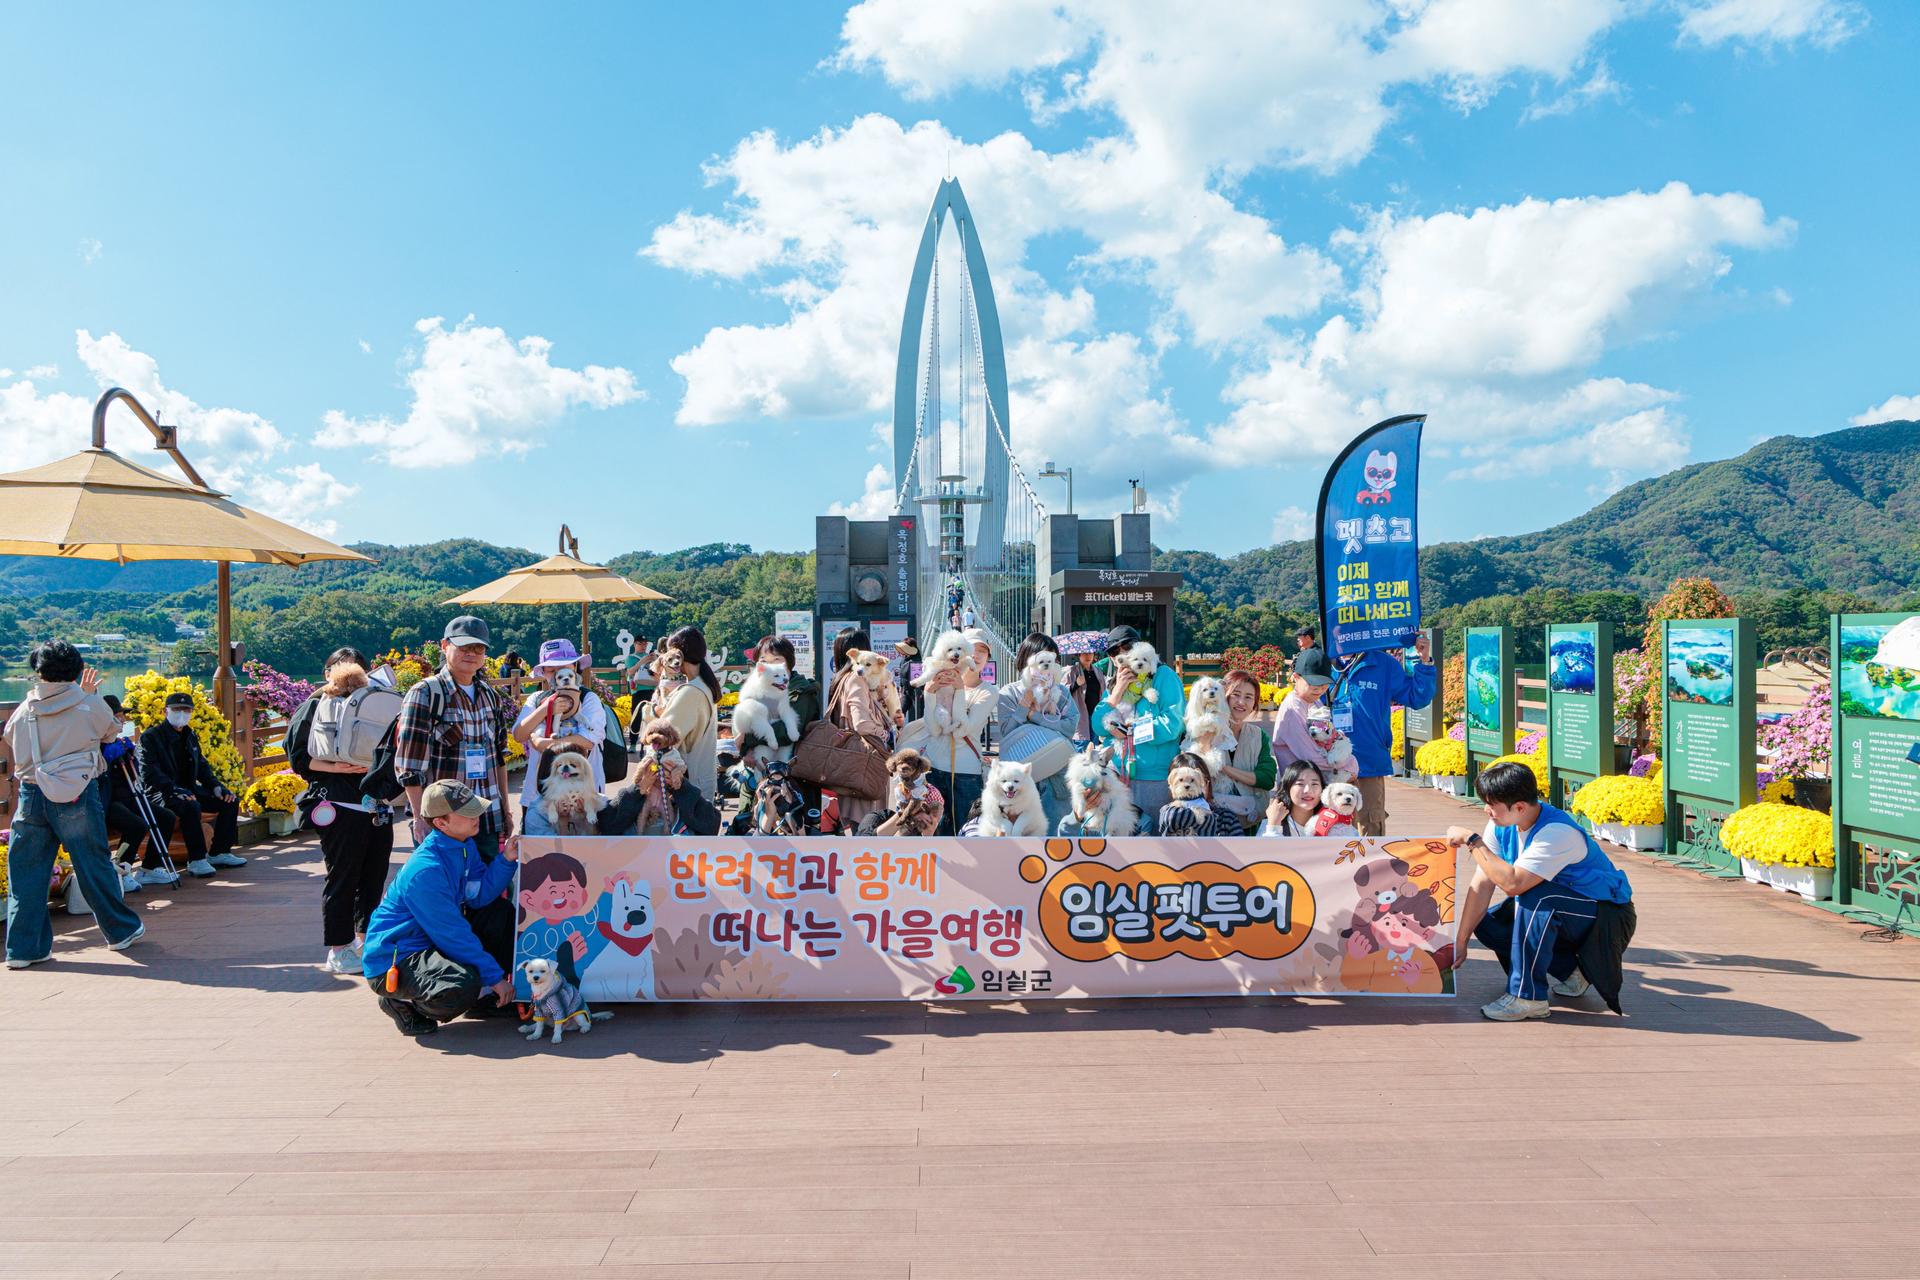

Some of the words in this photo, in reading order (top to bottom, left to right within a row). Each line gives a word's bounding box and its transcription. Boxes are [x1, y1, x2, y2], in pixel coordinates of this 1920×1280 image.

[1335, 514, 1413, 554] 펫츠고
[1337, 562, 1369, 581] 이제
[1085, 592, 1126, 602] 표(Ticket)
[1127, 592, 1144, 602] 받는
[1145, 592, 1153, 602] 곳
[1337, 583, 1370, 603] 펫과
[1374, 580, 1409, 599] 함께
[1338, 601, 1411, 624] 떠나세요!
[1338, 630, 1370, 643] 반려동물
[1373, 628, 1390, 638] 전문
[1852, 739, 1862, 768] 여름
[669, 851, 844, 899] 반려견과
[853, 851, 937, 901] 함께
[712, 909, 842, 957] 떠나는
[852, 909, 1023, 958] 가을여행
[981, 969, 1052, 992] 임실군
